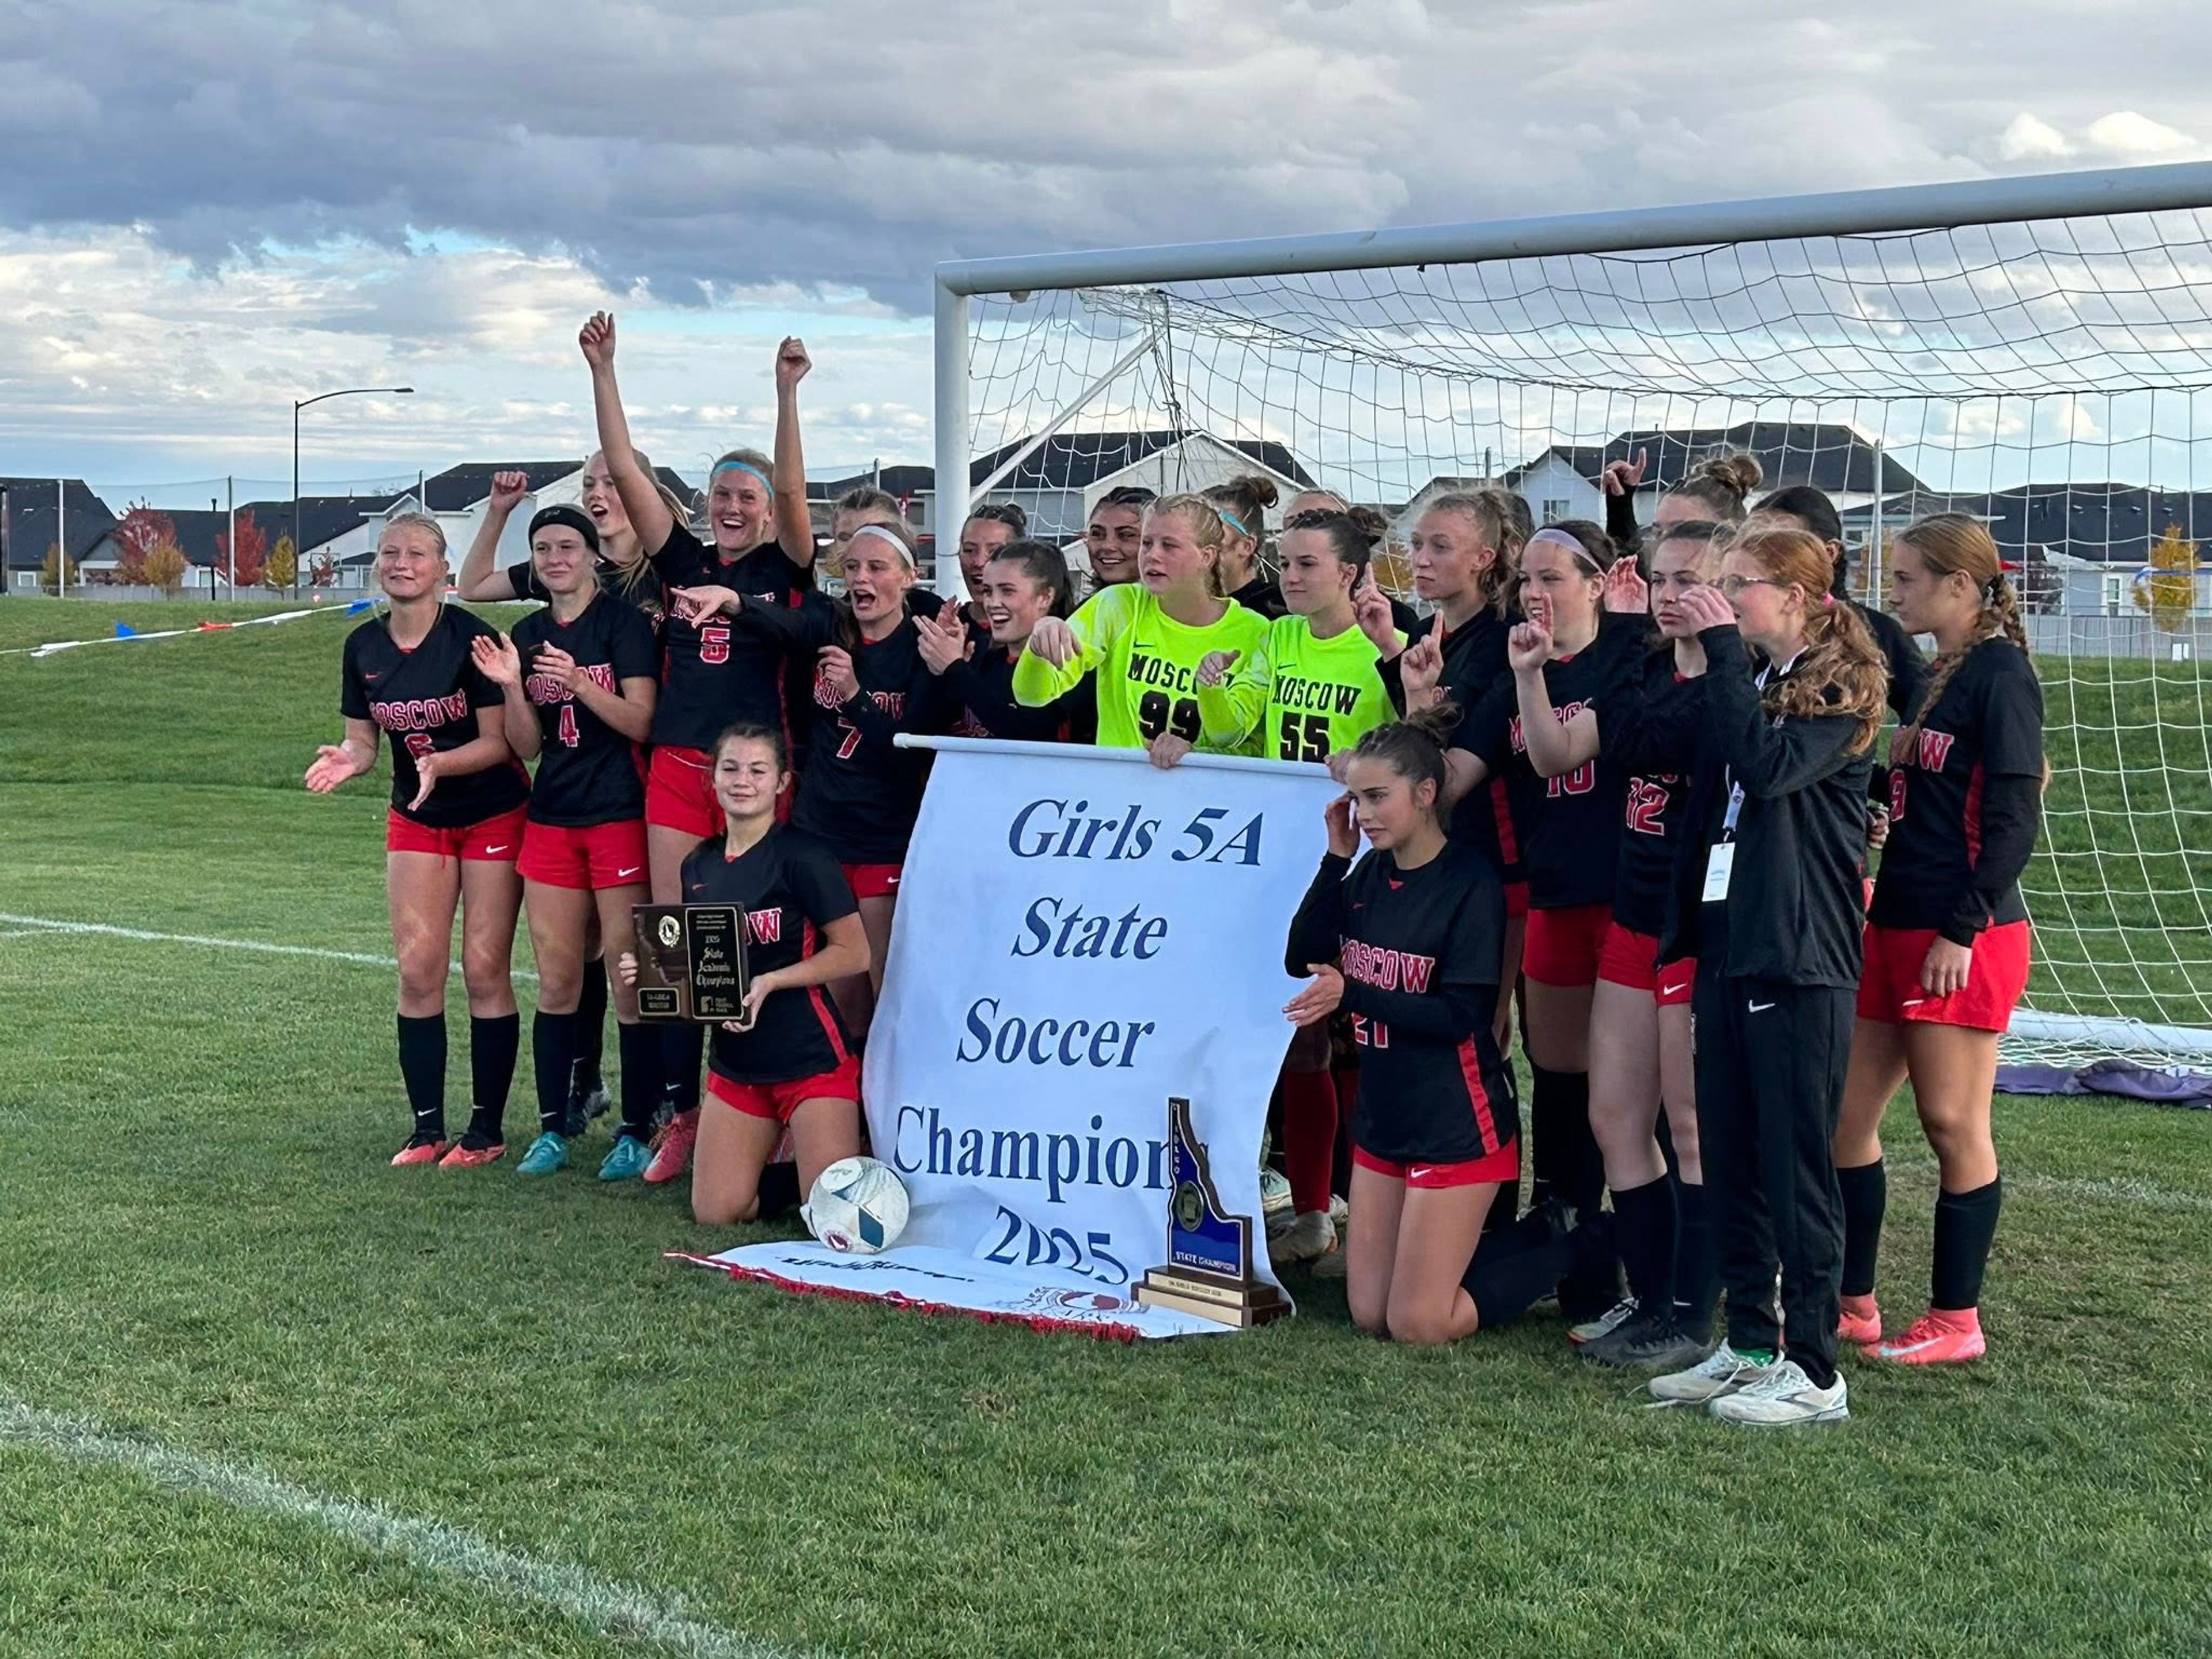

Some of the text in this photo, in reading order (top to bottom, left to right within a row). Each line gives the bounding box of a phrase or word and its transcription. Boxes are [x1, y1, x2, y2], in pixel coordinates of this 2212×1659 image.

[699, 627, 730, 664] 5
[1139, 690, 1202, 744] 99
[1272, 675, 1362, 715] MOSCOW
[559, 704, 580, 747] 4
[836, 717, 863, 759] 7
[1280, 711, 1330, 763] 55
[1008, 799, 1264, 866] Girls 5A
[1626, 777, 1670, 836] 12
[1010, 897, 1168, 960] State
[956, 998, 1156, 1068] Soccer
[894, 1105, 1209, 1203] Champion
